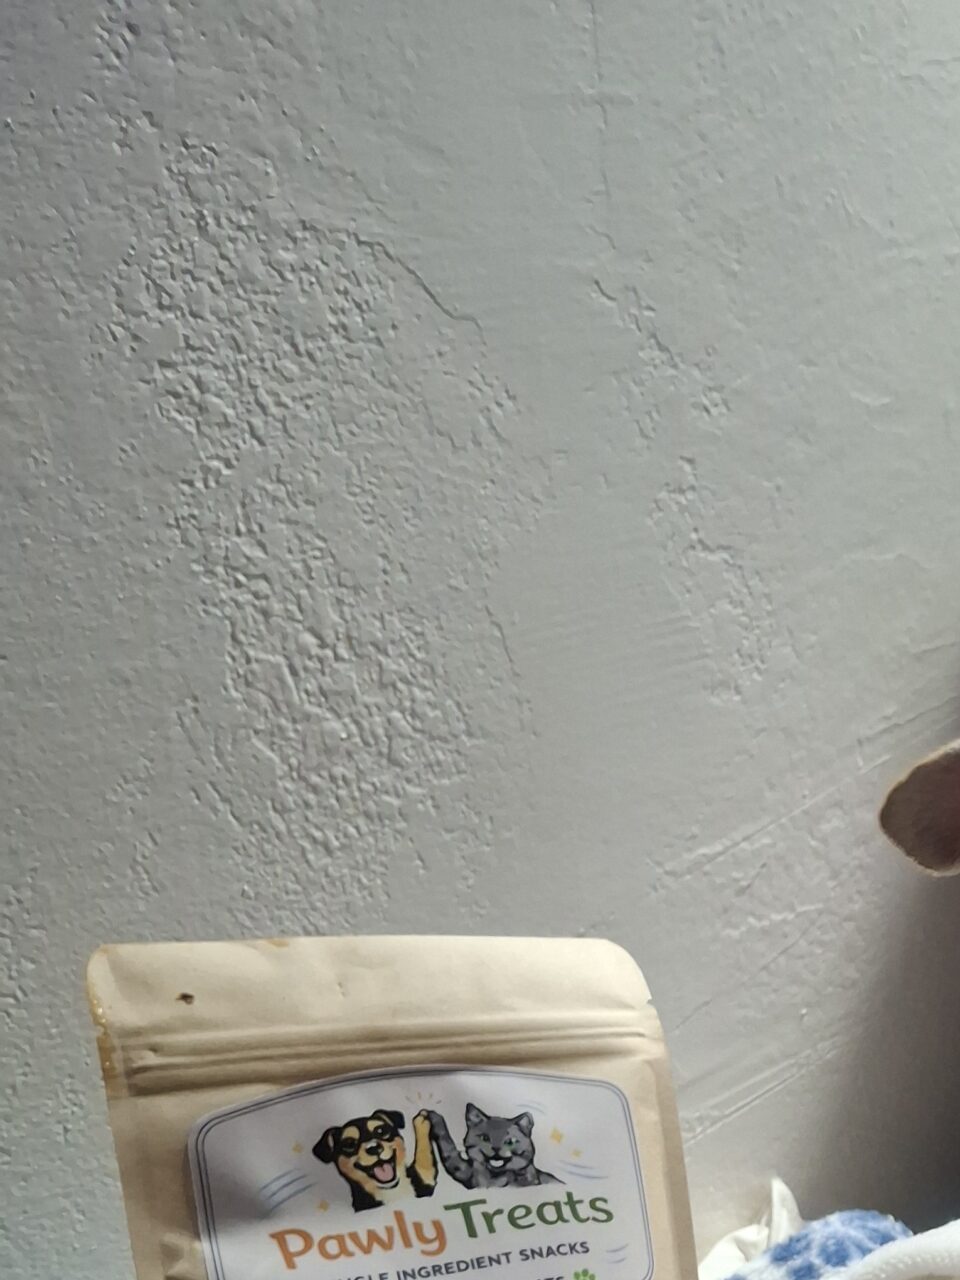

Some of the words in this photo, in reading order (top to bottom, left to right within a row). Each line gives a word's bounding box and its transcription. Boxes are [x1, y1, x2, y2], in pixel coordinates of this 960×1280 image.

[270, 1210, 447, 1270] Pawly
[444, 1191, 614, 1238] Treats
[519, 1241, 590, 1263] SNACKS
